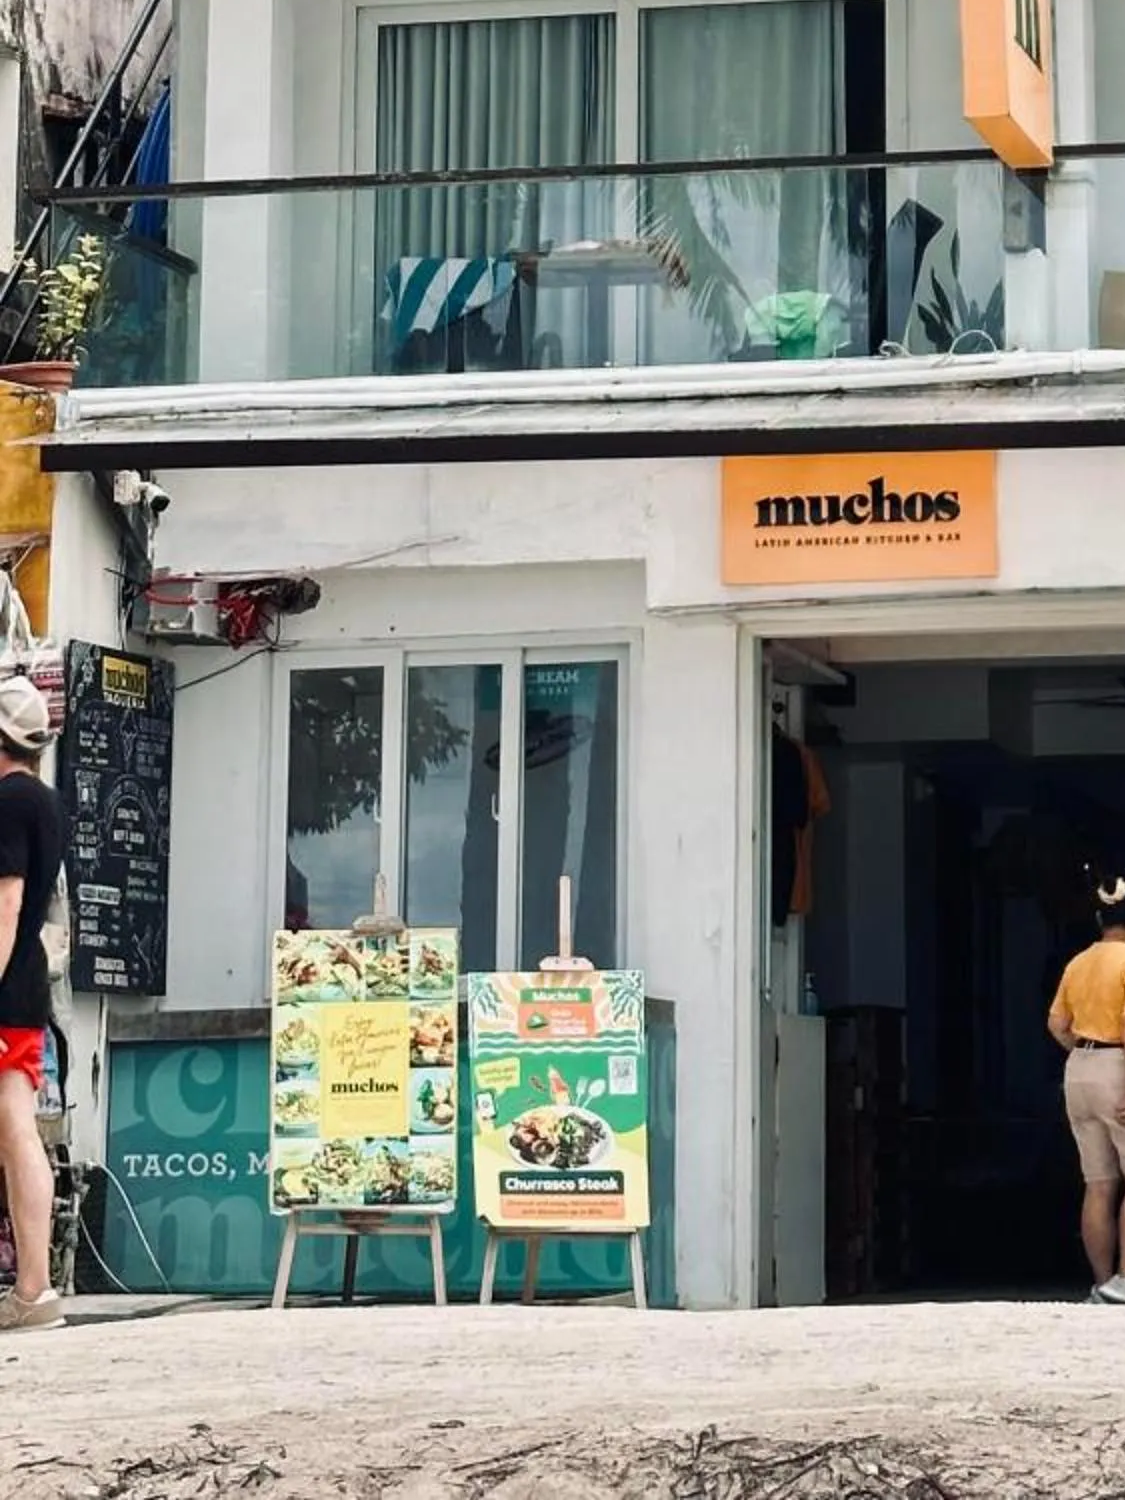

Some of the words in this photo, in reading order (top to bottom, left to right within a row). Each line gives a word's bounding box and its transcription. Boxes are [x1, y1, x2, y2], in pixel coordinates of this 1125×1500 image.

[754, 476, 961, 528] muchos
[755, 537, 791, 549] LATIN
[795, 535, 859, 547] AMERICAN
[865, 534, 920, 545] KITCHEN
[938, 533, 961, 542] BAR
[331, 1077, 399, 1093] muchos
[124, 1153, 236, 1181] TACOS,
[505, 1176, 576, 1192] Churrasco
[578, 1175, 620, 1192] Steak
